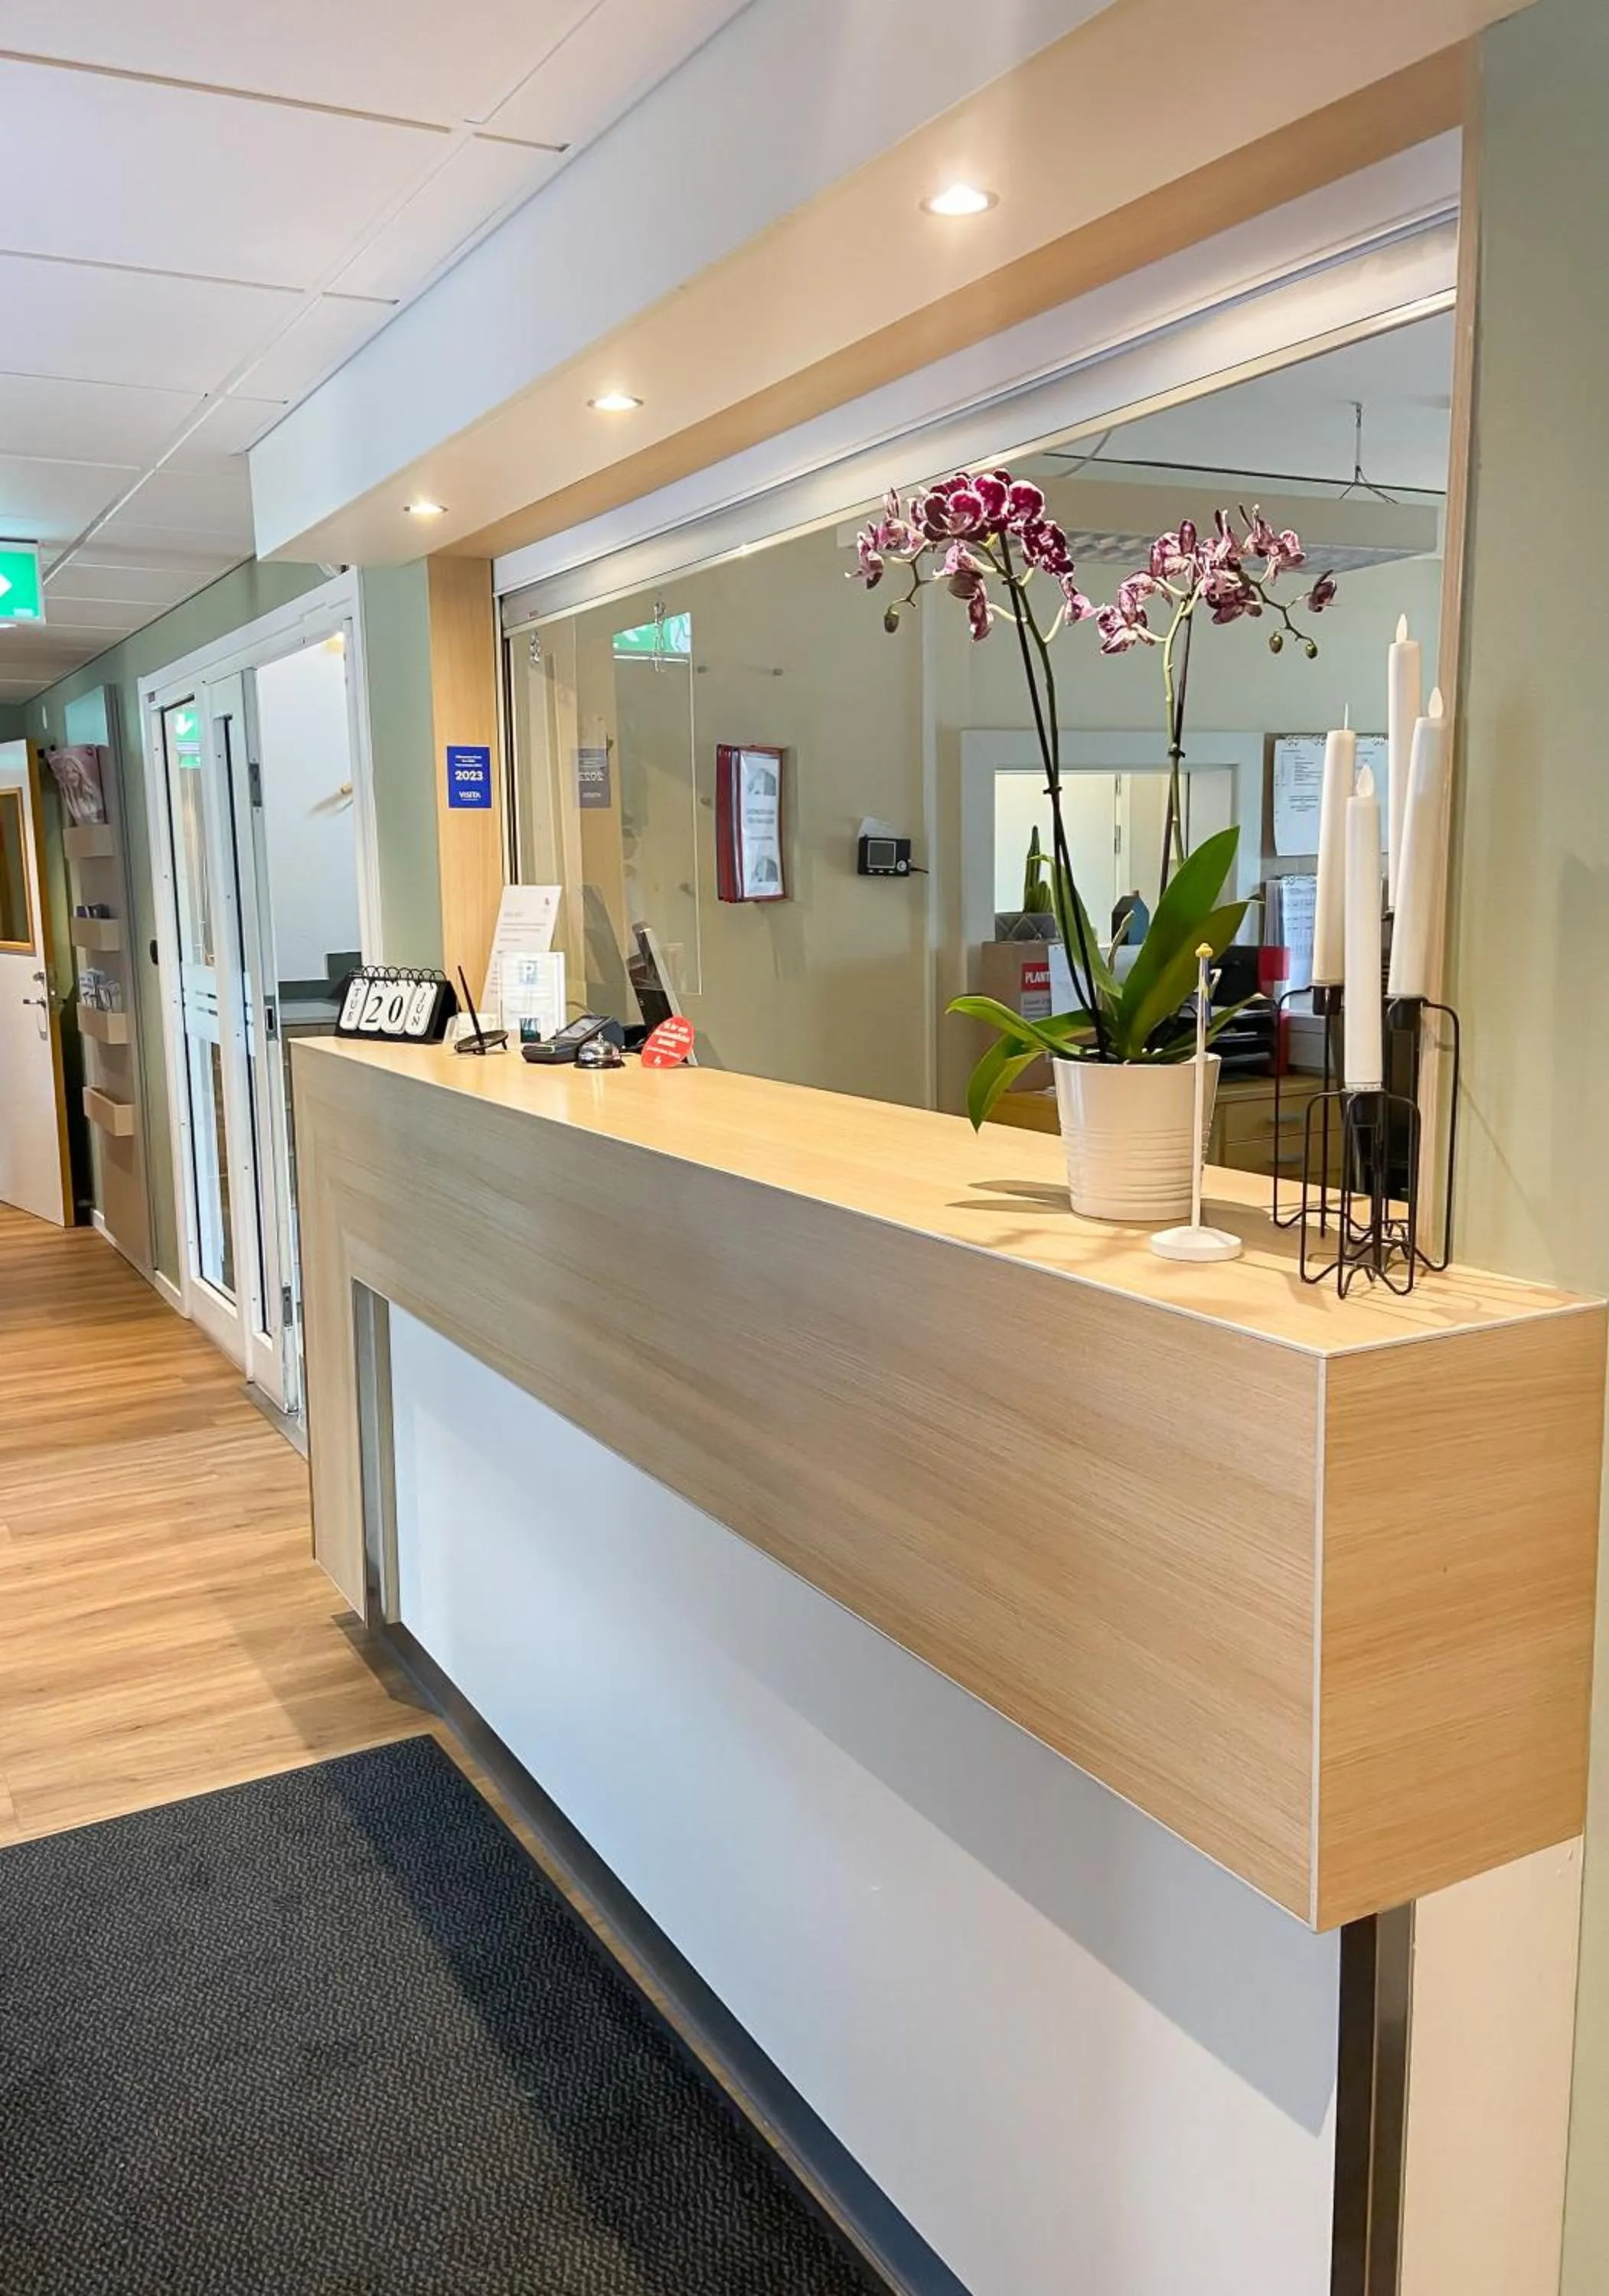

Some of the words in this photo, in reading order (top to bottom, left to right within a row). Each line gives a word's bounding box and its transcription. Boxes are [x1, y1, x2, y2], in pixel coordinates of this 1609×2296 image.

[455, 771, 483, 781] 2023
[347, 987, 361, 1022] TUE
[365, 996, 403, 1023] 20
[412, 991, 426, 1026] JUN
